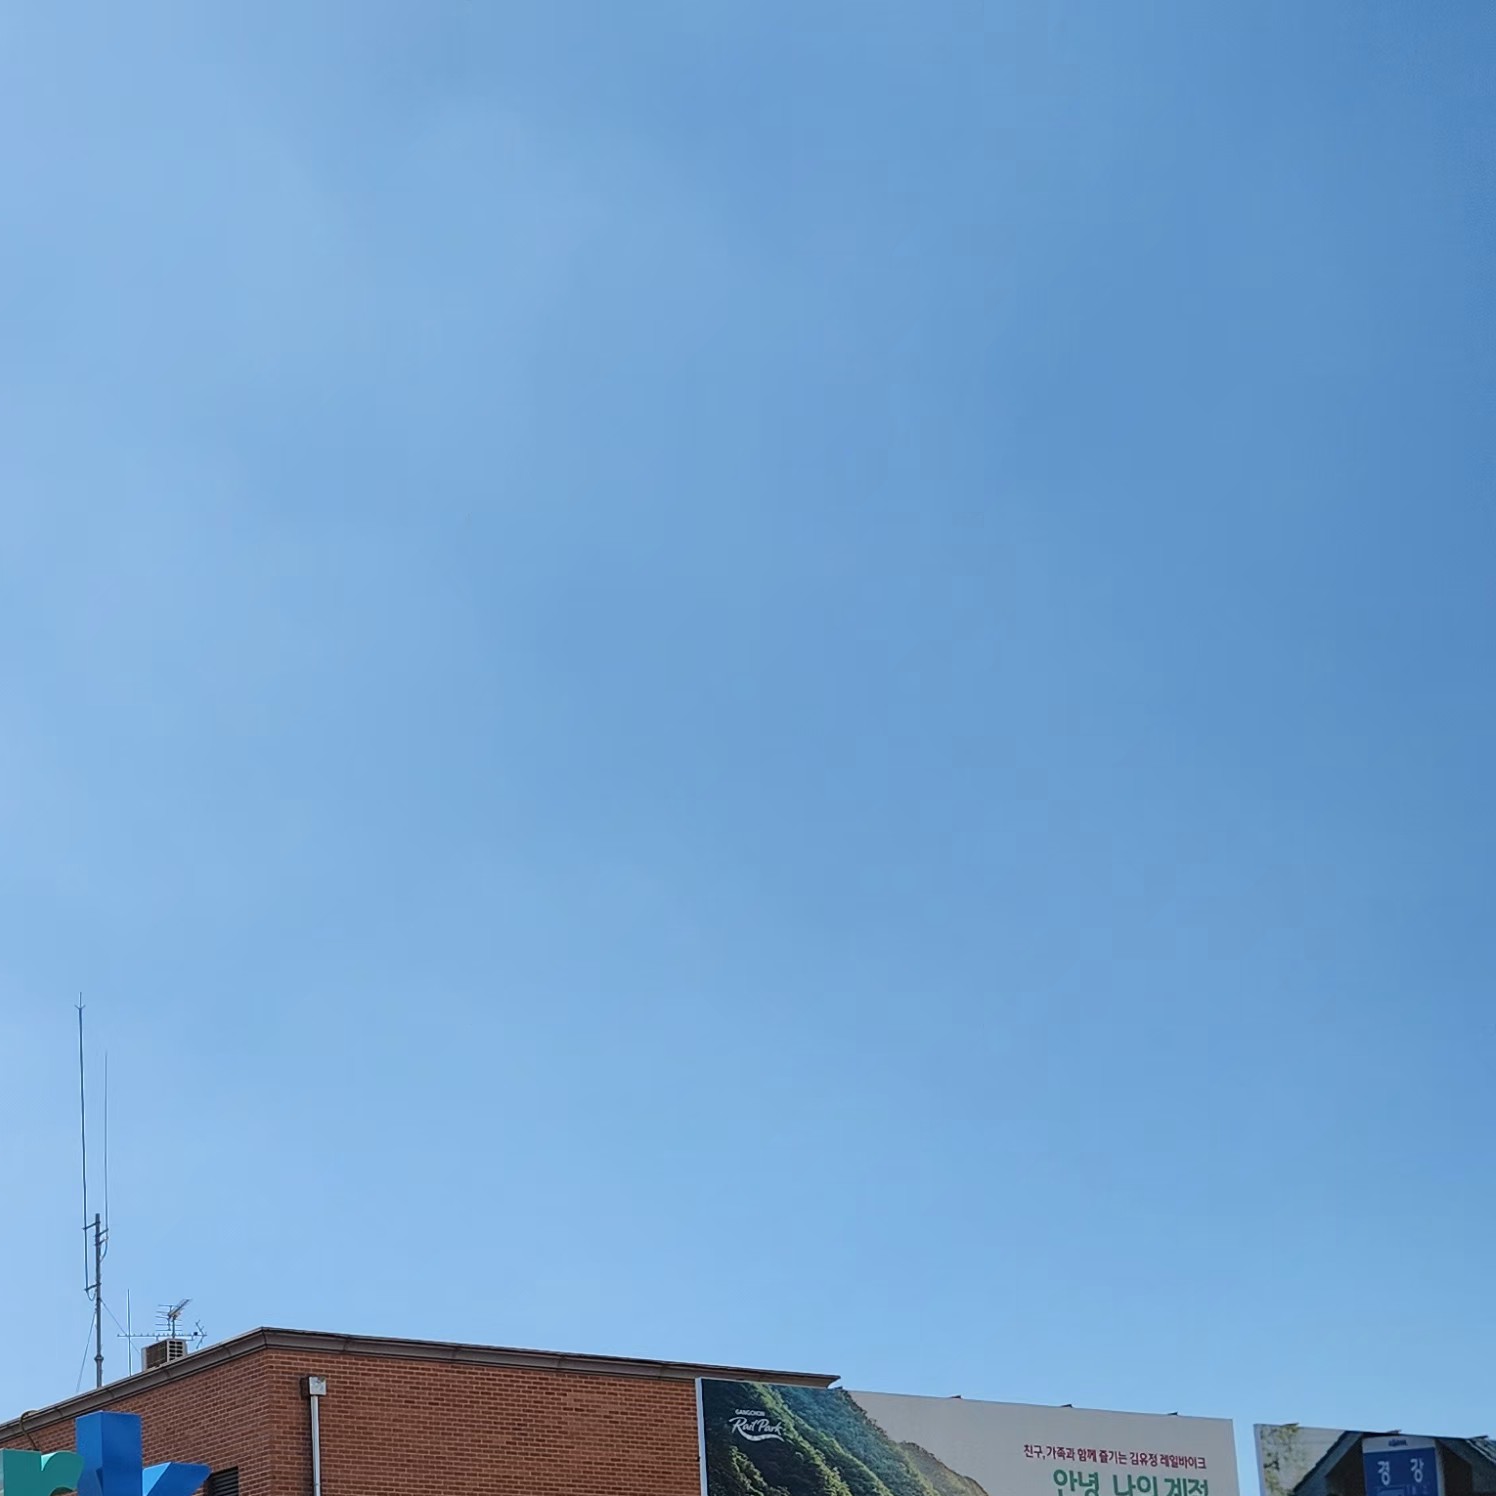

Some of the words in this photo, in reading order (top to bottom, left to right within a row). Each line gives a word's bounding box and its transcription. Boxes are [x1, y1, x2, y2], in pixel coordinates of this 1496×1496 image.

[728, 1416, 758, 1435] Rail
[757, 1418, 784, 1436] Park
[1077, 1448, 1097, 1462] 함께
[1099, 1449, 1127, 1465] 즐기는
[1129, 1451, 1158, 1467] 김유정
[1159, 1453, 1207, 1470] 레일바이크
